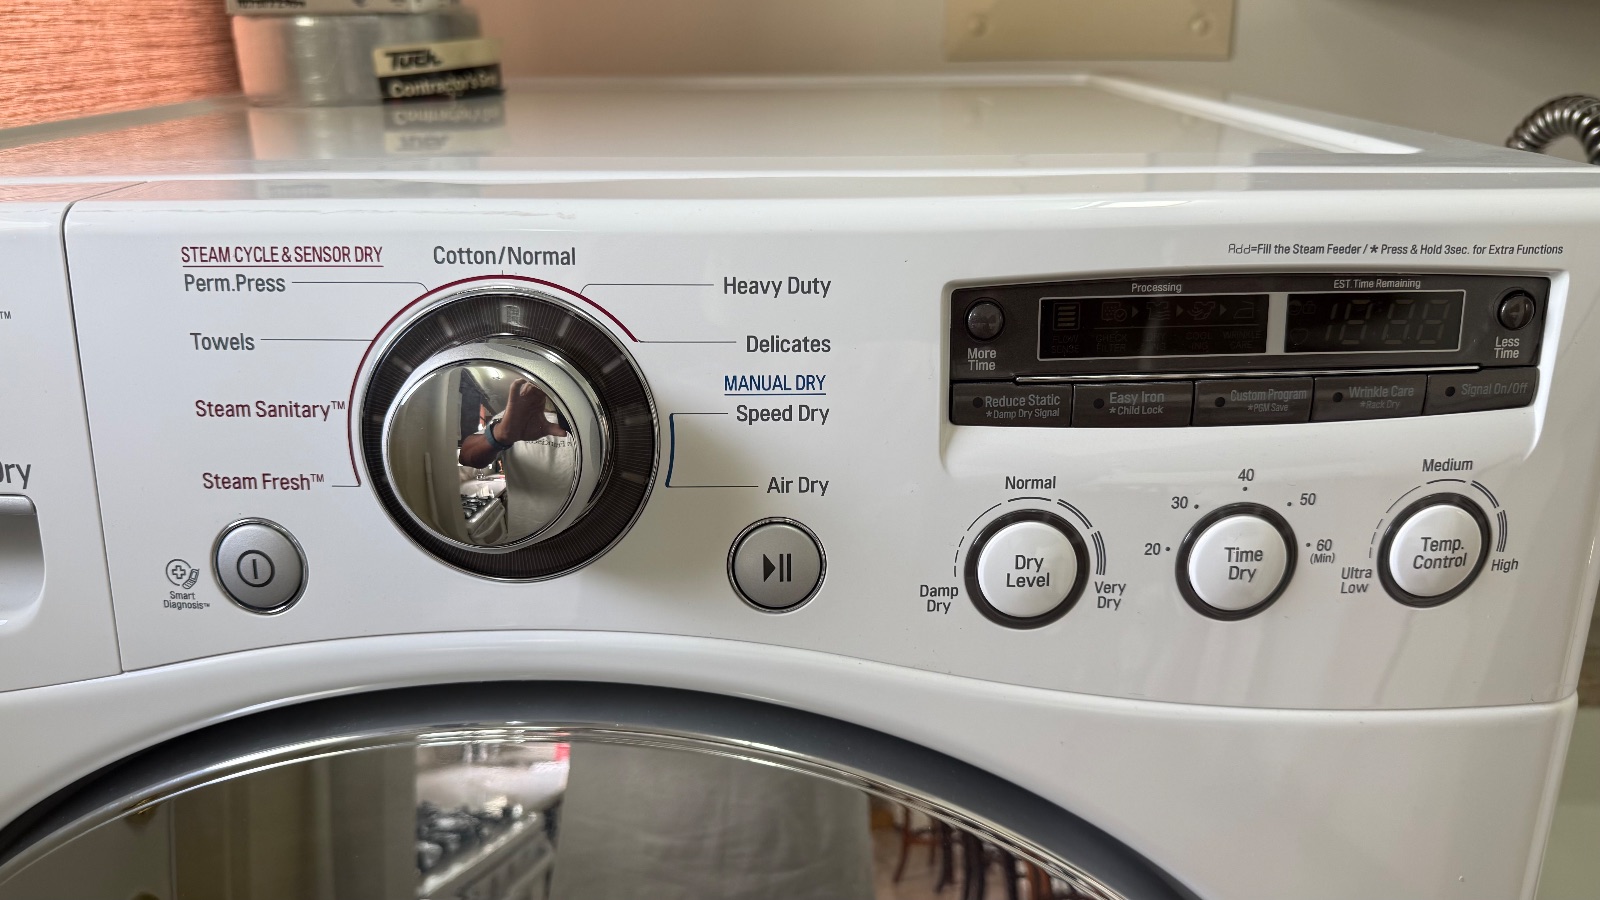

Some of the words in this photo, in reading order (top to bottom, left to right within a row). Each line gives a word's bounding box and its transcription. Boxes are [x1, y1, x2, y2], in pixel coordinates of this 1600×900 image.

[181, 246, 231, 263] STEAM
[234, 246, 279, 263] CYCLE
[281, 247, 292, 262] &
[294, 246, 351, 263] SENSOR
[354, 246, 382, 263] DRY
[433, 245, 576, 266] Cotton/Normal
[1274, 243, 1290, 254] the
[1292, 243, 1325, 254] Steam
[1327, 243, 1361, 254] Feeder
[1410, 244, 1418, 254] &
[1420, 244, 1442, 254] Hold
[1444, 244, 1470, 254] 3sec.
[1472, 244, 1487, 254] for
[1488, 244, 1514, 254] Extra
[1517, 244, 1563, 254] Functions
[184, 273, 286, 292] Perm.Press
[723, 277, 783, 298] Heavy
[788, 277, 832, 298] Duty
[1131, 282, 1182, 294] Processing
[1353, 279, 1374, 289] Time
[1375, 279, 1421, 290] Remaining
[190, 332, 255, 350] Towels
[746, 336, 831, 353] Delicates
[1495, 336, 1520, 348] Less
[967, 347, 997, 360] More
[1494, 348, 1519, 359] Time
[968, 359, 996, 371] Time
[724, 375, 792, 391] MANUAL
[795, 375, 826, 391] DRY
[1461, 383, 1492, 396] Signal
[1493, 382, 1528, 395] On/Off
[1109, 391, 1138, 405] Easy
[1140, 391, 1165, 403] Iron
[1230, 389, 1266, 401] Custom
[1268, 388, 1307, 402] Program
[1349, 386, 1389, 398] Wrinkle
[1391, 385, 1414, 397] Care
[984, 395, 1026, 408] Reduce
[1028, 394, 1061, 406] Static
[1270, 402, 1288, 412] Save
[1386, 400, 1400, 410] Dry
[195, 400, 251, 417] Steam
[736, 405, 793, 426] Speed
[798, 405, 830, 426] Dry
[1018, 408, 1034, 420] Dry
[1034, 407, 1060, 420] Signal
[1141, 405, 1163, 415] Lock
[1422, 459, 1473, 473] Medium
[202, 472, 257, 490] Steam
[1238, 468, 1254, 482] 40
[767, 476, 793, 494] Air
[798, 477, 829, 497] Dry
[1005, 476, 1056, 490] Normal
[1171, 496, 1188, 510] 30
[1300, 493, 1316, 506] 50
[1144, 543, 1161, 556] 20
[1316, 539, 1332, 551] 60
[1421, 536, 1465, 554] Temp.
[1225, 547, 1263, 562] Time
[1310, 552, 1335, 565] (Min)
[1413, 553, 1467, 570] Control
[1015, 554, 1044, 572] Dry
[1491, 558, 1519, 573] High
[1228, 566, 1257, 583] Dry
[1341, 566, 1372, 580] Ultra
[1006, 573, 1050, 588] Level
[919, 584, 959, 600] Damp
[1094, 581, 1126, 596] Very
[1340, 582, 1369, 594] Low
[169, 591, 196, 601] Smart
[927, 600, 951, 614] Dry
[1097, 596, 1121, 611] Dry
